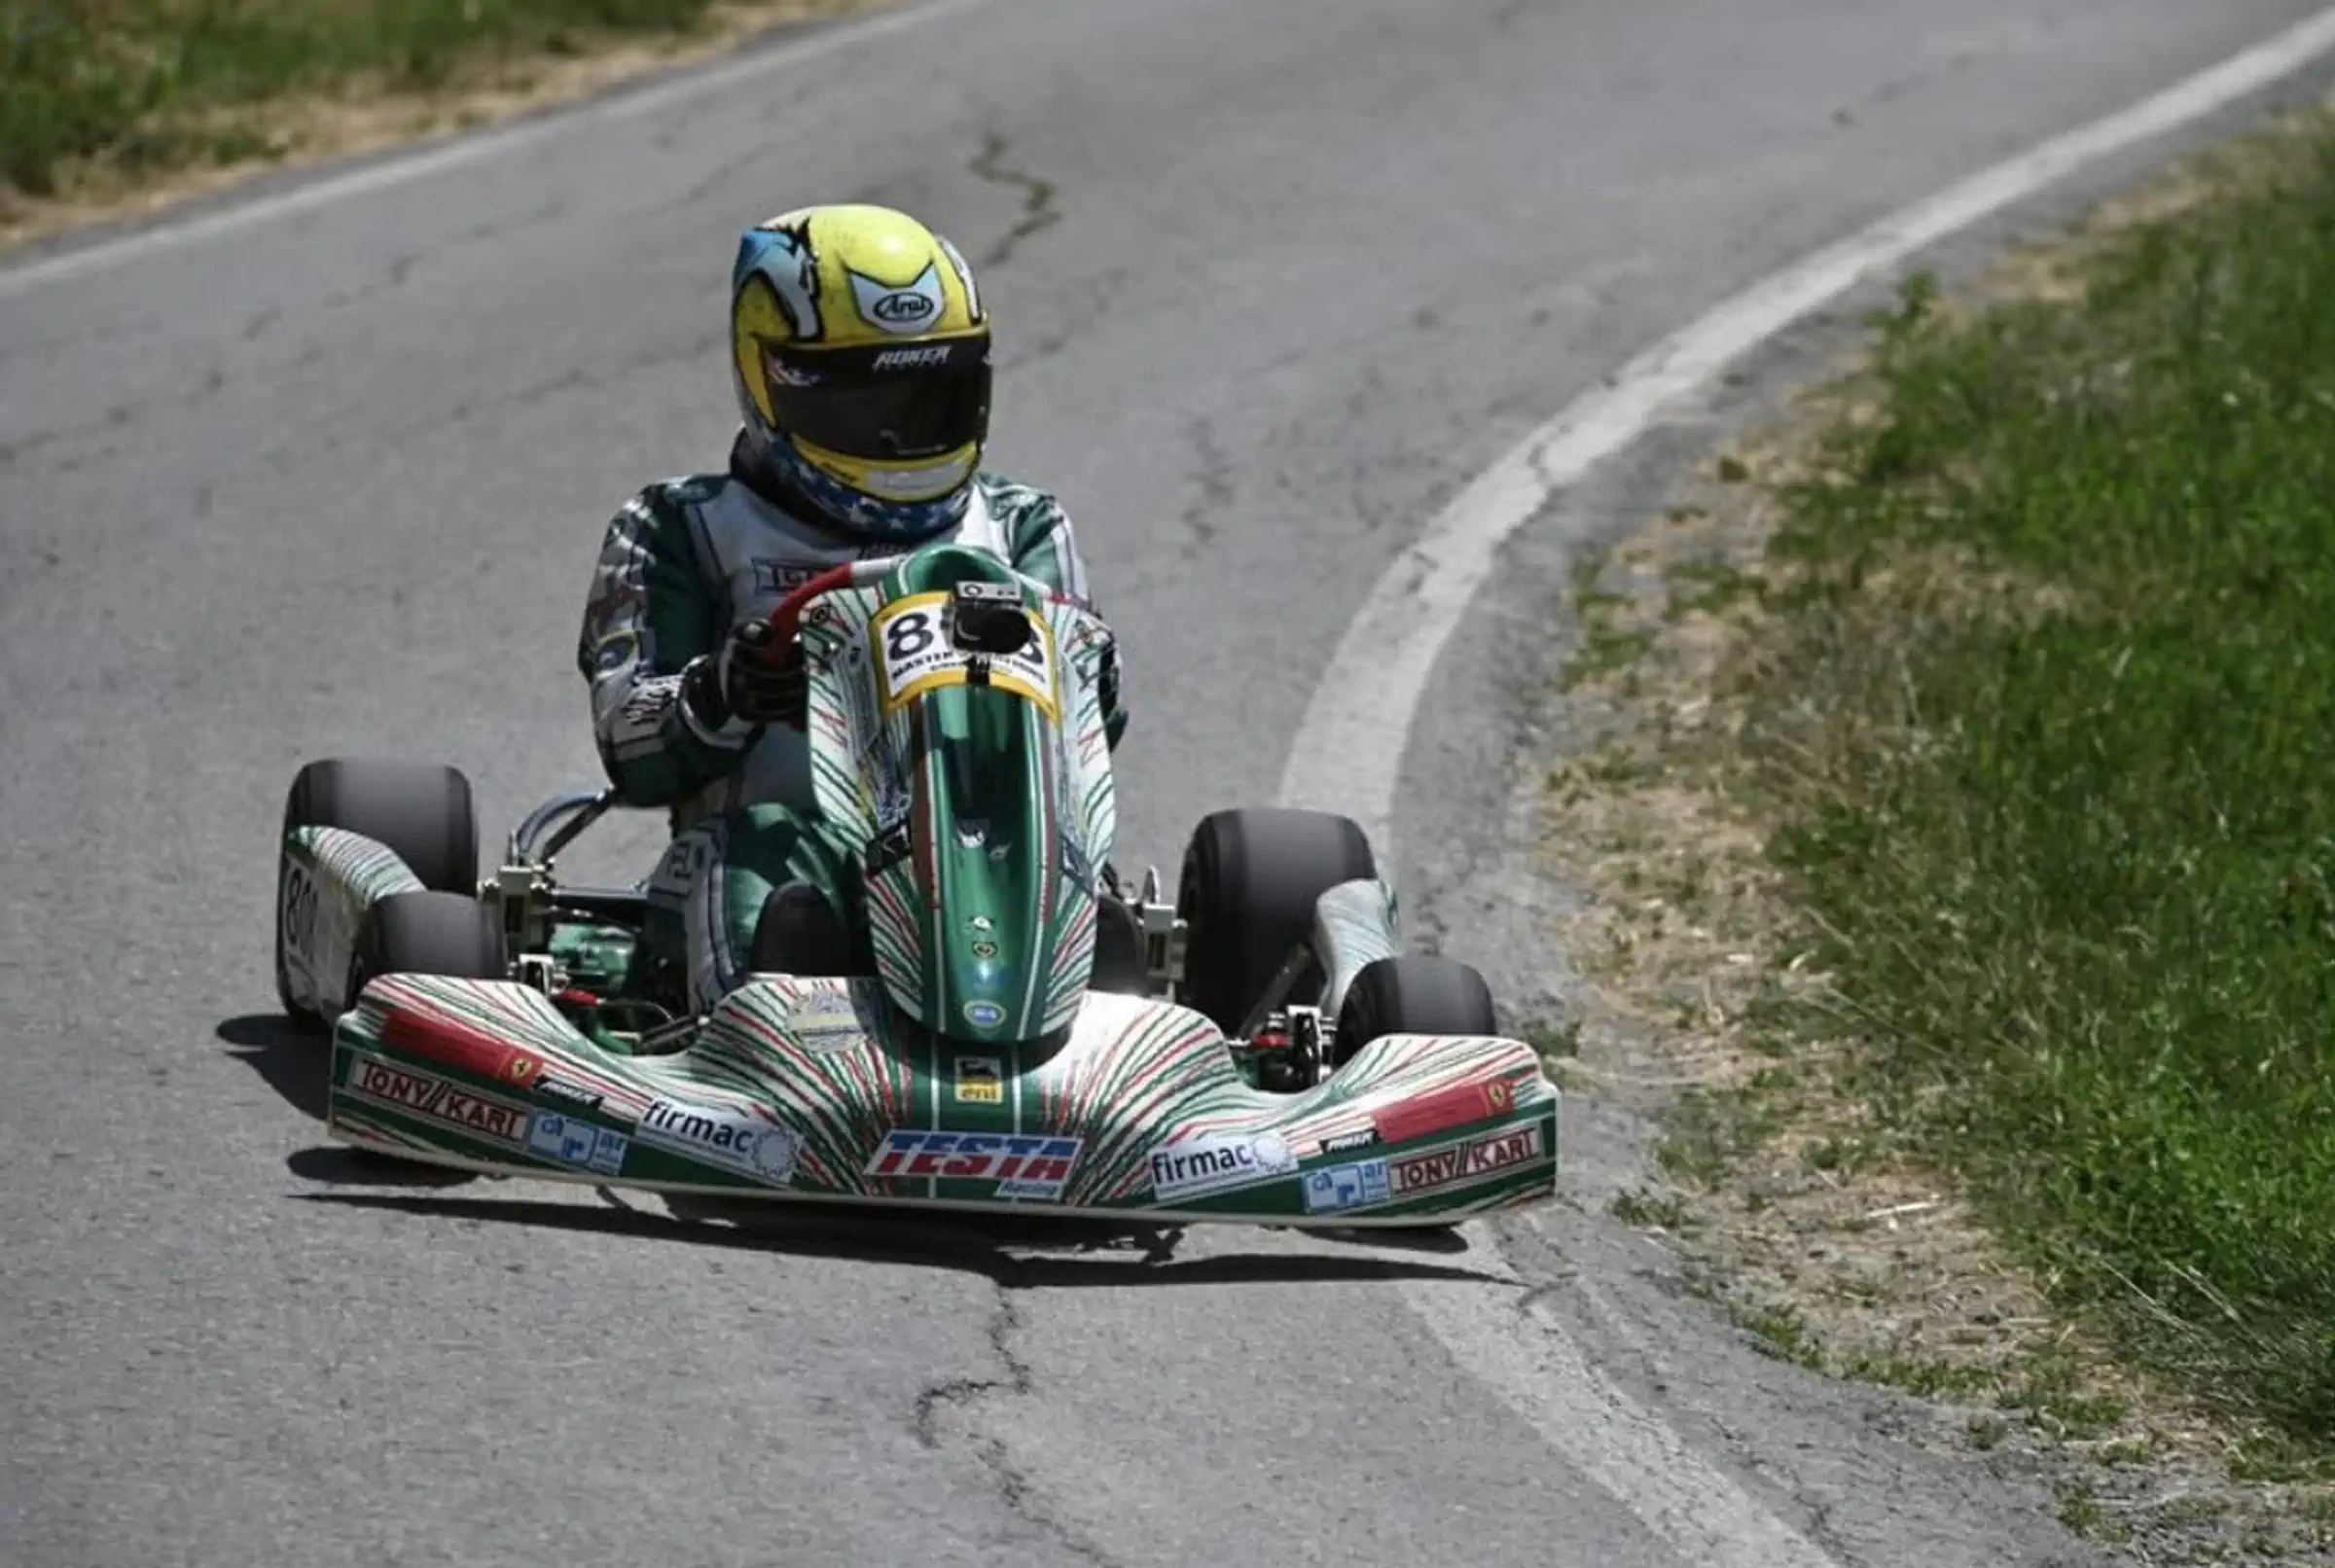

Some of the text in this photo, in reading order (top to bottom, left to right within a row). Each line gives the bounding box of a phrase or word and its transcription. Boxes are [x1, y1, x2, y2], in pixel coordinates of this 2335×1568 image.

[445, 1087, 528, 1144] KART
[643, 1100, 754, 1153] firmac
[1152, 1143, 1253, 1185] firmac
[1472, 1127, 1536, 1170] KART
